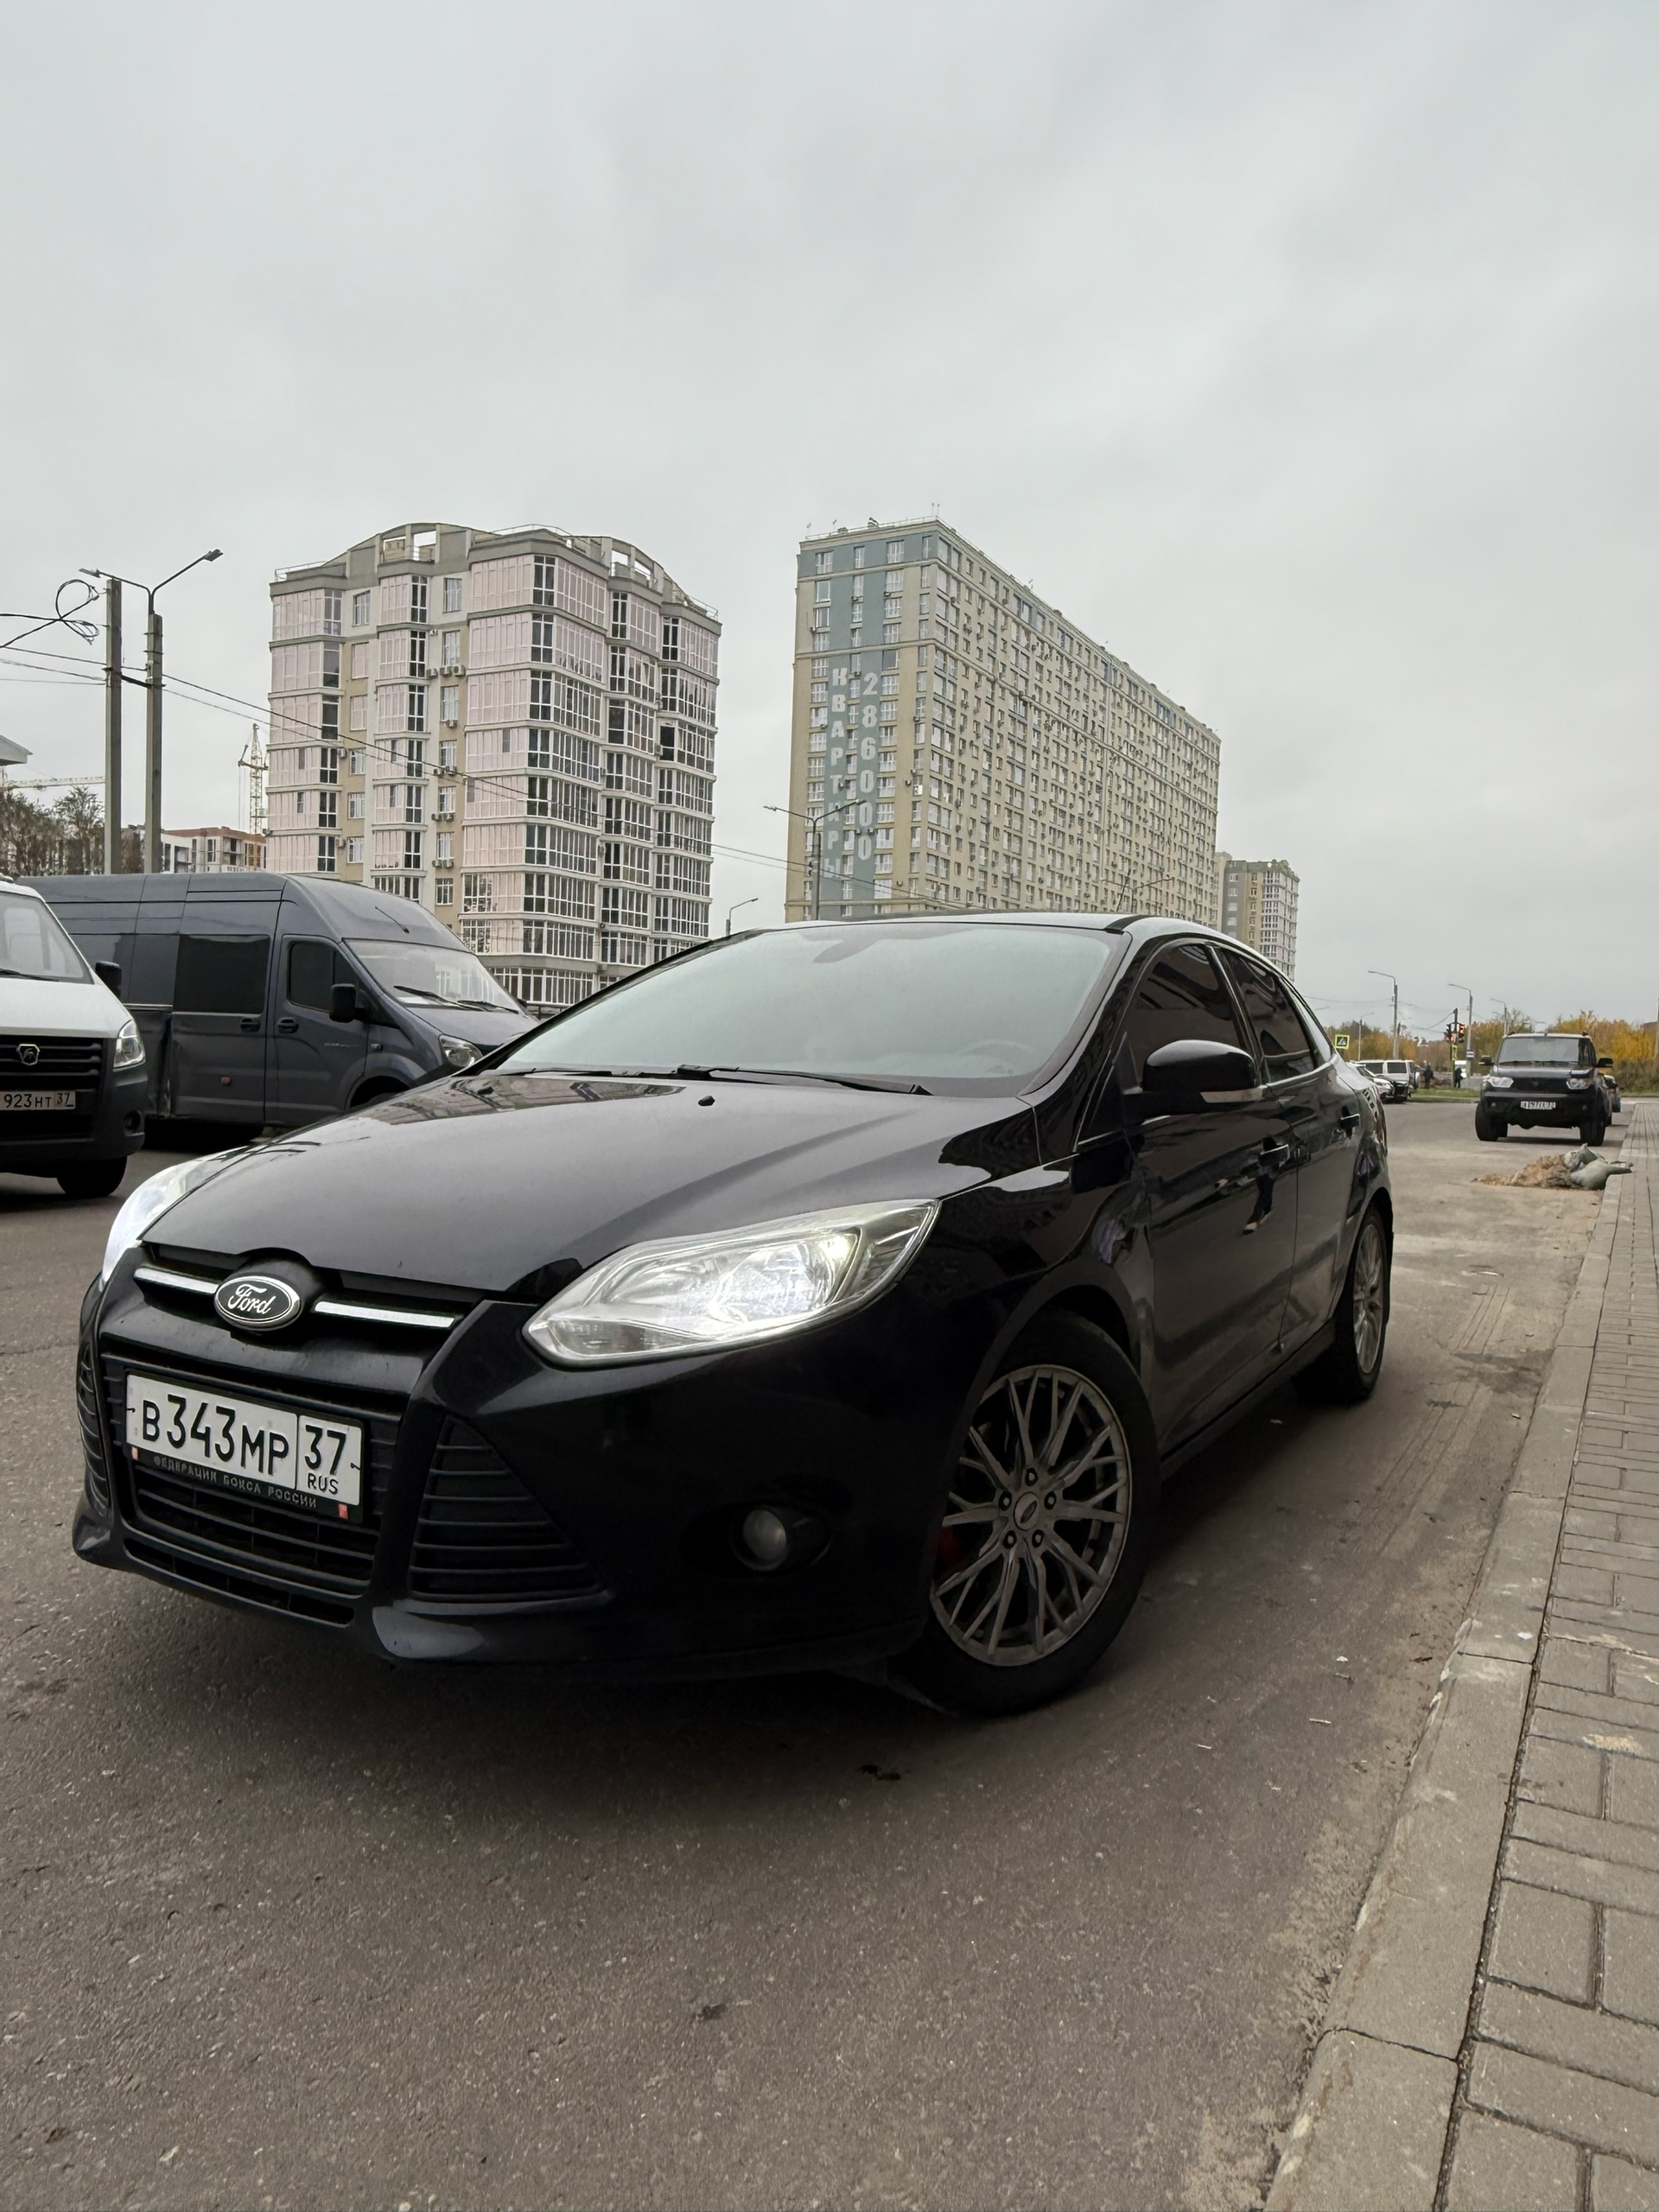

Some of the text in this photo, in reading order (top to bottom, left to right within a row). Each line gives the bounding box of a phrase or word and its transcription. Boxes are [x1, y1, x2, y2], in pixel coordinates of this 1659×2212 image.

[823, 667, 848, 879] КВАРТИРЫ
[858, 672, 878, 861] 286000
[227, 1284, 276, 1314] Ford
[143, 1395, 346, 1476] В343МР 37
[268, 1485, 317, 1510] РОССИИ
[307, 1472, 339, 1495] RUS
